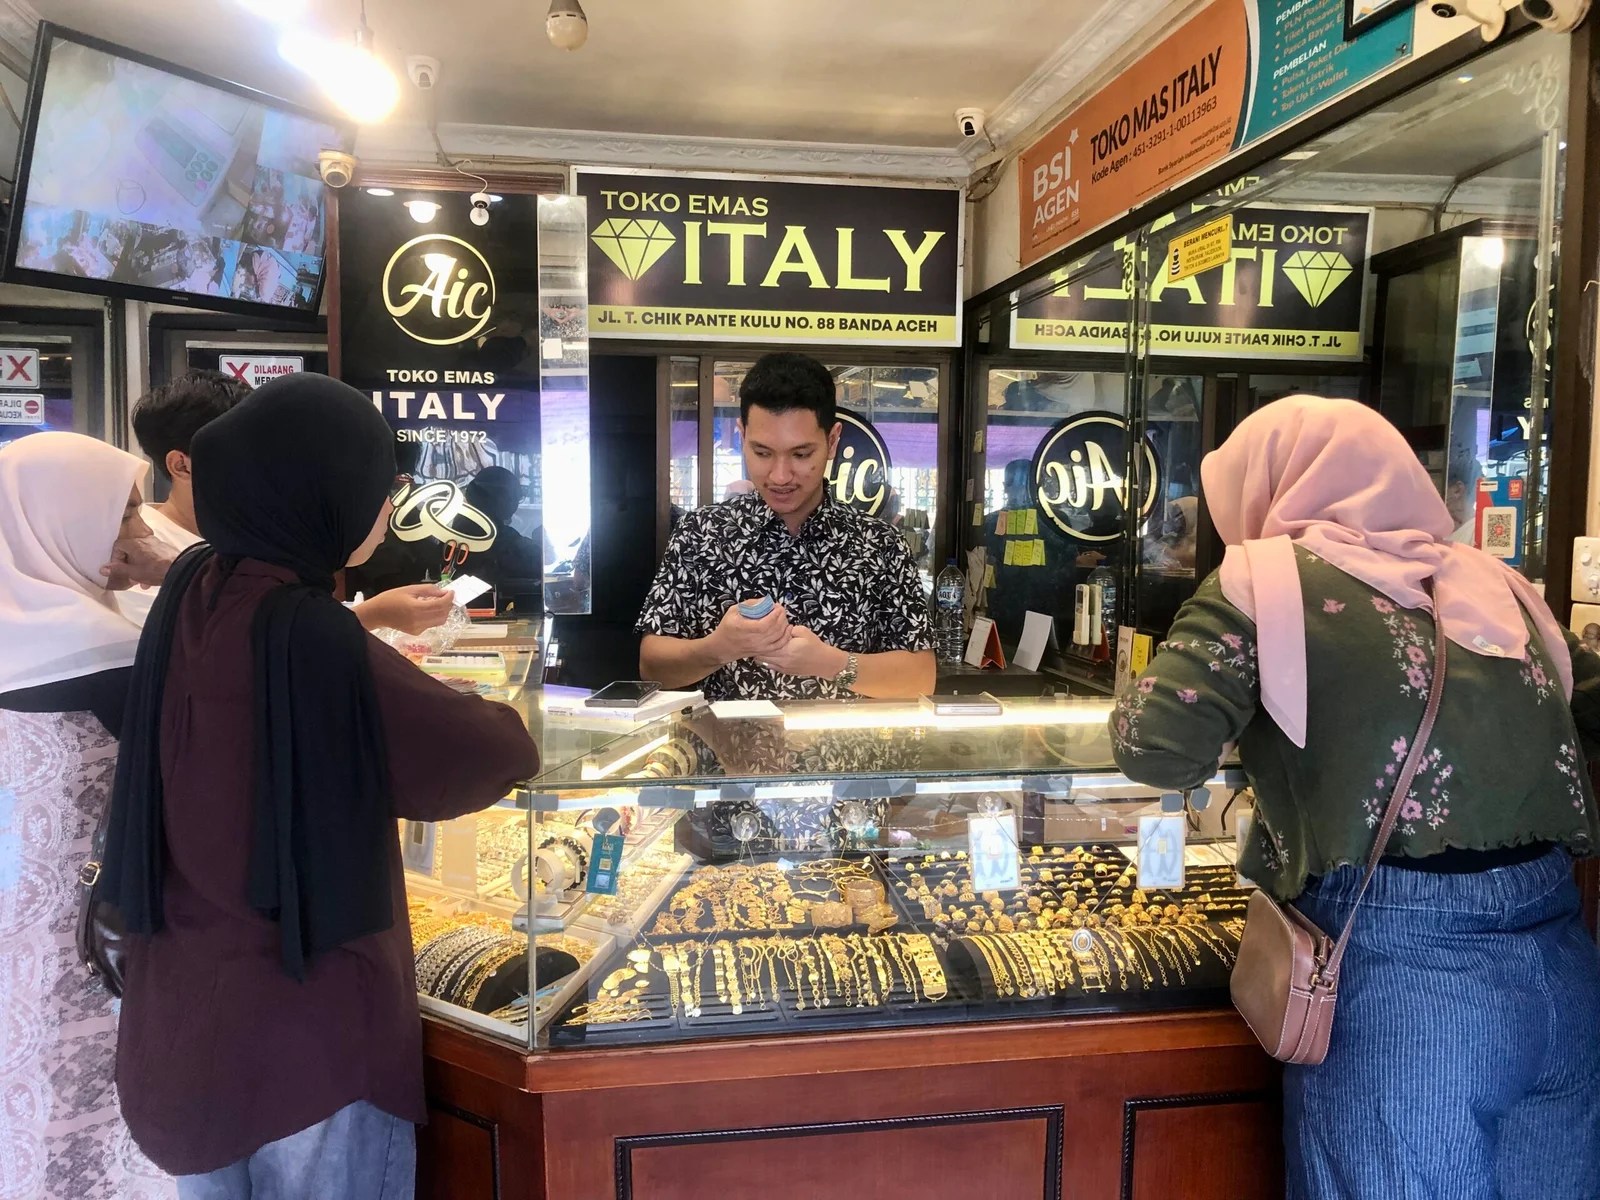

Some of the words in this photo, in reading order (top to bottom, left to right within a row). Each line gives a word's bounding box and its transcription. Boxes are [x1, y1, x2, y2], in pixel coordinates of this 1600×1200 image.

[1273, 40, 1327, 79] PEMBELIAN
[1090, 117, 1130, 165] TOKO
[1133, 86, 1169, 139] MAS
[1172, 45, 1222, 113] ITALY
[1091, 166, 1109, 185] Kode
[1110, 154, 1128, 173] Agen
[1133, 95, 1217, 156] 451-3291-1-00113963
[1033, 146, 1071, 202] BSI
[600, 190, 680, 213] TOKO
[688, 195, 769, 217] EMAS
[1032, 180, 1080, 229] AGEN
[683, 219, 946, 293] ITALY
[400, 253, 490, 319] Aic
[598, 310, 620, 325] JL.
[624, 312, 638, 325] T.
[641, 312, 681, 326] CHIK
[685, 313, 736, 328] PANTE
[740, 314, 781, 329] KULU
[785, 316, 813, 330] NO.
[817, 318, 835, 330] 88
[839, 318, 892, 332] BANDA
[895, 320, 937, 333] ACEH
[254, 365, 294, 374] DILARANG
[387, 369, 438, 382] TOKO
[444, 371, 495, 384] EMAS
[372, 391, 505, 420] ITALY
[396, 430, 446, 442] SINCE
[450, 430, 487, 443] 1972
